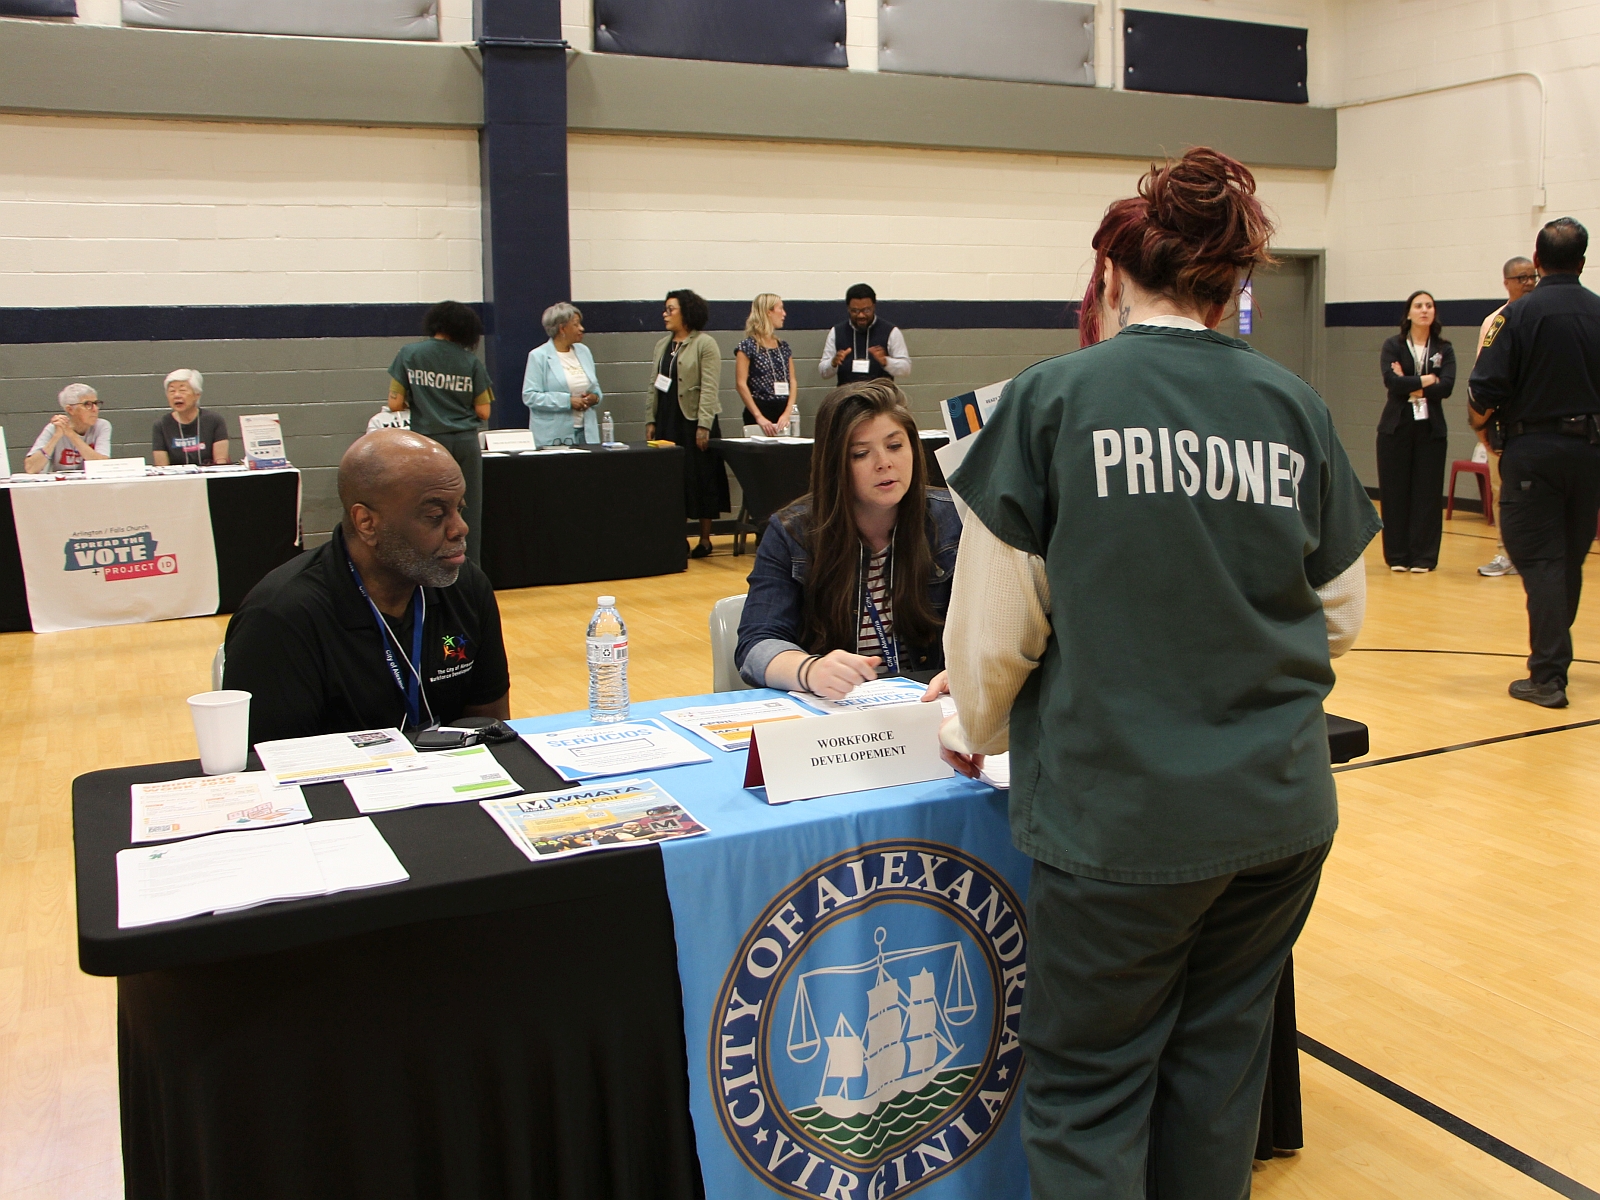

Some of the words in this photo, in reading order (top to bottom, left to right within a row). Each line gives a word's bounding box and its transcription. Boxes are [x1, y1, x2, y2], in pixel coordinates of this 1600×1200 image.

[407, 368, 473, 393] PRISONER
[1092, 427, 1305, 511] PRISONER
[72, 529, 103, 537] Arlington
[126, 524, 150, 532] Church
[73, 539, 120, 550] SPREAD
[122, 536, 145, 545] THE
[74, 544, 148, 567] VOTE
[105, 562, 155, 575] PROJECT
[161, 561, 172, 569] ID
[385, 649, 394, 662] City
[833, 692, 920, 706] SERVICES
[546, 728, 653, 748] SERVICIOS
[817, 730, 895, 749] WORKFORCE
[810, 745, 907, 767] DEVELOPEMENT
[548, 786, 642, 803] WMATA
[559, 799, 588, 808] Job
[591, 795, 621, 803] Fair
[720, 986, 766, 1127] CITY
[746, 900, 804, 979] OF
[815, 851, 1027, 1060] ALEXANDRIA
[767, 1088, 1009, 1200] VIRGINIA
